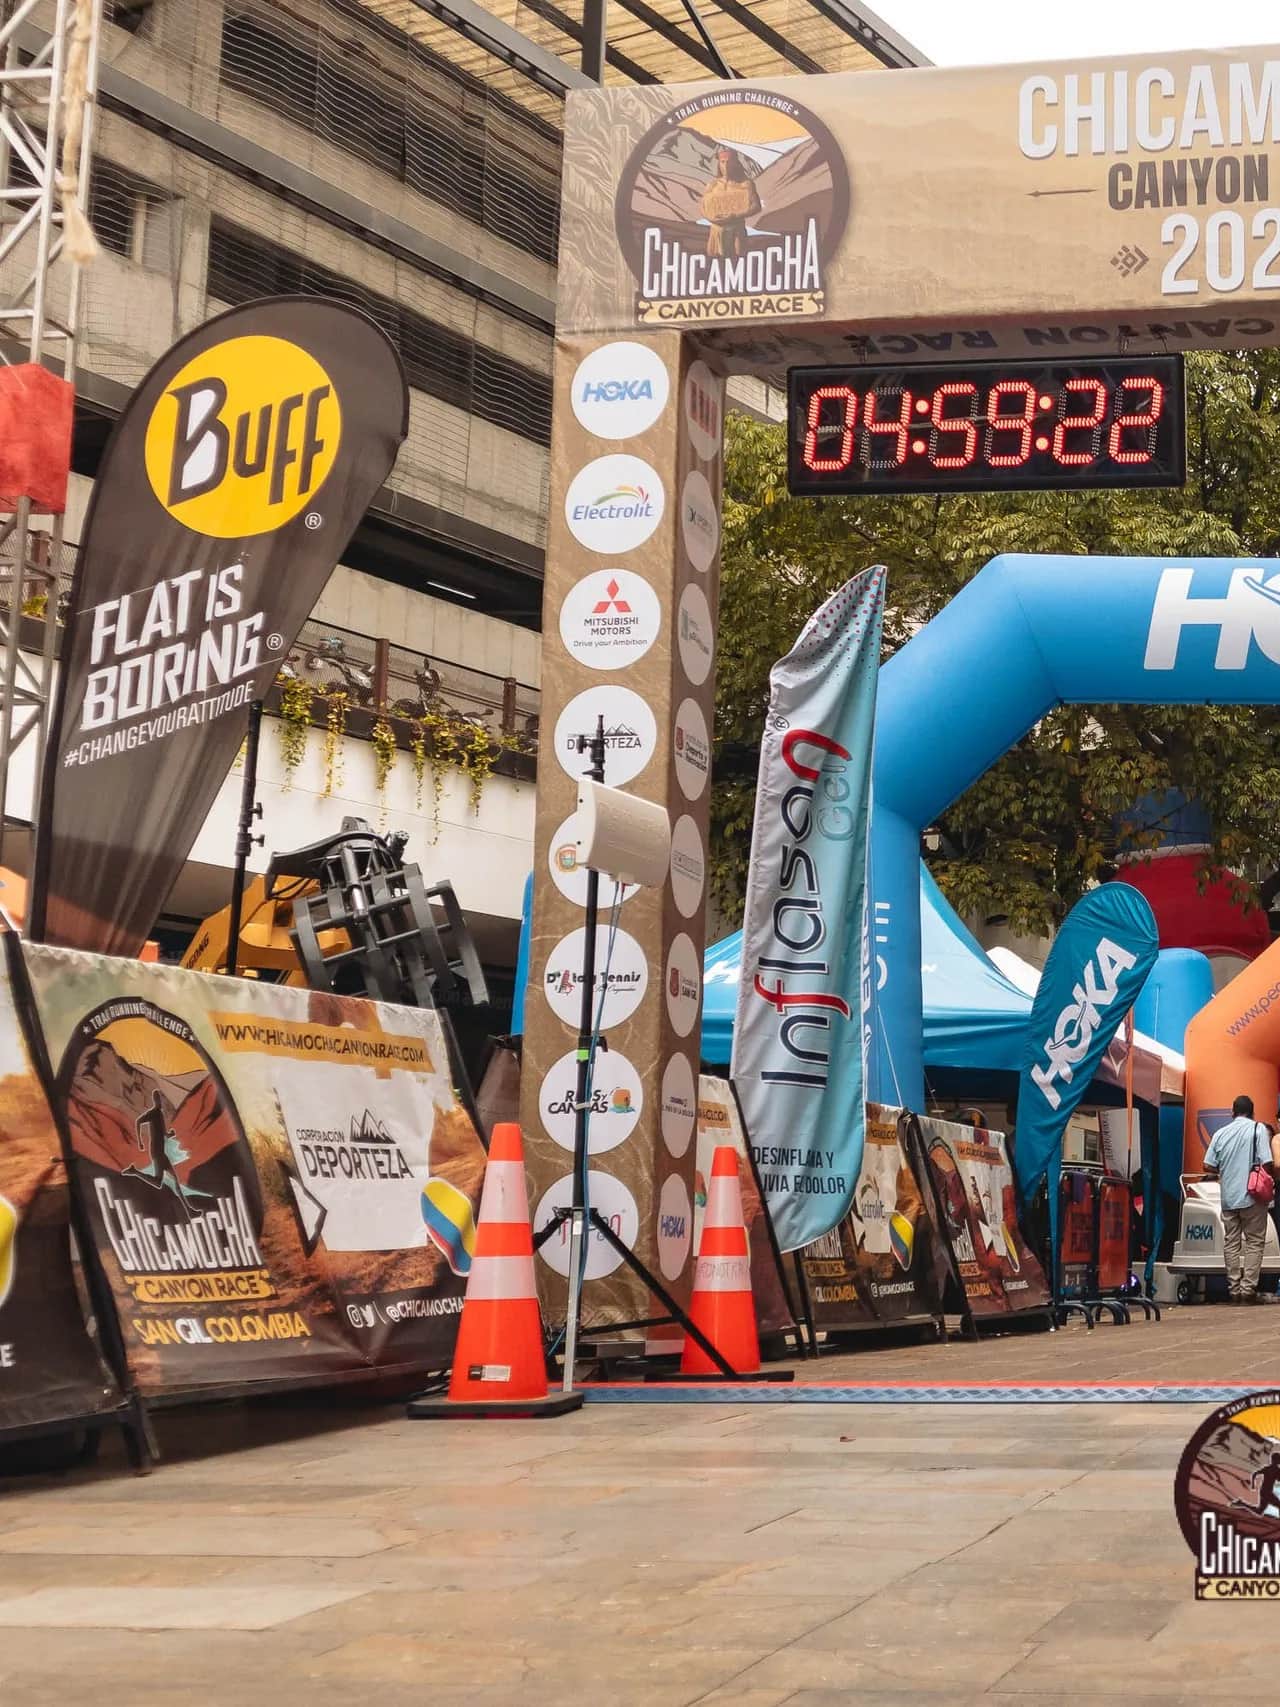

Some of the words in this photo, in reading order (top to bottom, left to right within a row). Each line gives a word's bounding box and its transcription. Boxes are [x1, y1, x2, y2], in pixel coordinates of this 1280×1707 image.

[675, 104, 699, 121] TRAIL
[702, 92, 742, 107] RUNNING
[744, 92, 794, 113] CHALLENGE
[1107, 153, 1268, 211] CANYON
[642, 218, 820, 298] CHICAMOCHA
[658, 299, 745, 319] CANYON
[750, 296, 804, 314] RACE
[582, 379, 653, 403] HOKA
[802, 376, 1164, 472] 04:59:22
[573, 503, 653, 520] Electrolit
[90, 568, 203, 664] FLAT
[205, 564, 244, 621] IS
[584, 616, 639, 627] MITSUBISHI
[573, 640, 593, 648] Drive
[594, 640, 611, 649] your
[613, 638, 648, 646] Ambition
[591, 626, 631, 636] MOTORS
[80, 612, 264, 731] BORING
[64, 680, 255, 768] #CHANGEYOURATTITUDE
[567, 737, 642, 750] DRTEZA
[600, 971, 641, 984] Tennis
[90, 1011, 110, 1030] TRAI
[145, 1007, 189, 1038] HALLENGE
[1031, 937, 1137, 1111] HOKA
[548, 1102, 608, 1114] CANAS
[565, 1090, 602, 1102] RS
[300, 1143, 415, 1179] DEPORTEZA
[825, 1151, 834, 1169] Y
[762, 1174, 790, 1193] IVIA
[805, 1176, 846, 1195] DOLOR
[94, 1175, 263, 1272] CHICAMOCHA
[661, 1214, 686, 1239] HOKA
[1186, 1224, 1214, 1241] HOKA
[144, 1278, 213, 1300] CANYON
[217, 1275, 260, 1296] RACE
[386, 1296, 465, 1322] @CHICAMOCHA
[207, 1313, 311, 1344] COLOMBIA
